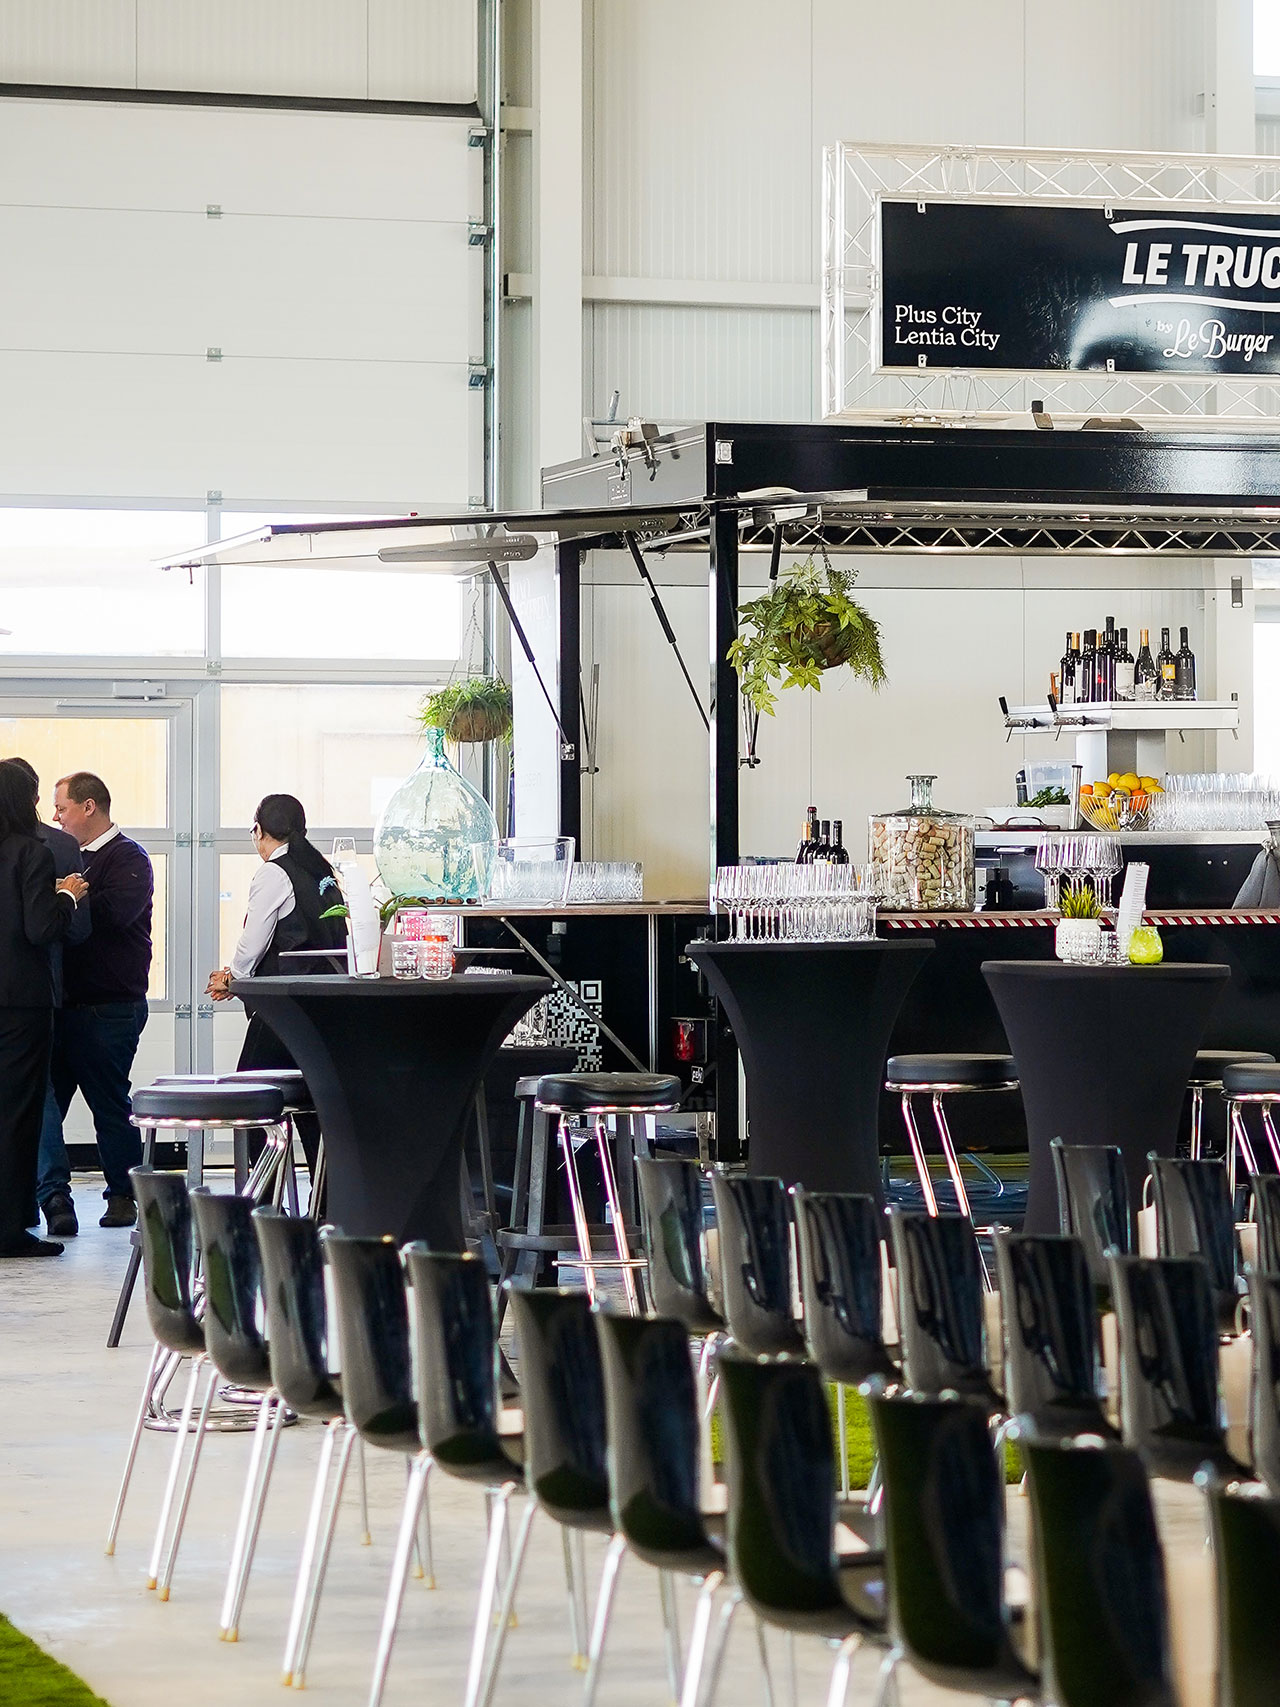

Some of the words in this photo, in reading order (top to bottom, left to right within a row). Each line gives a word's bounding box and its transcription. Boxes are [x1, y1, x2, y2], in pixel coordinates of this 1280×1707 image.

[1122, 242, 1173, 286] LE
[894, 304, 938, 323] Plus
[942, 306, 983, 329] City
[1156, 320, 1174, 334] by
[894, 326, 957, 346] Lentia
[960, 328, 1001, 351] City
[1162, 318, 1199, 358] Le
[1199, 319, 1275, 362] Burger
